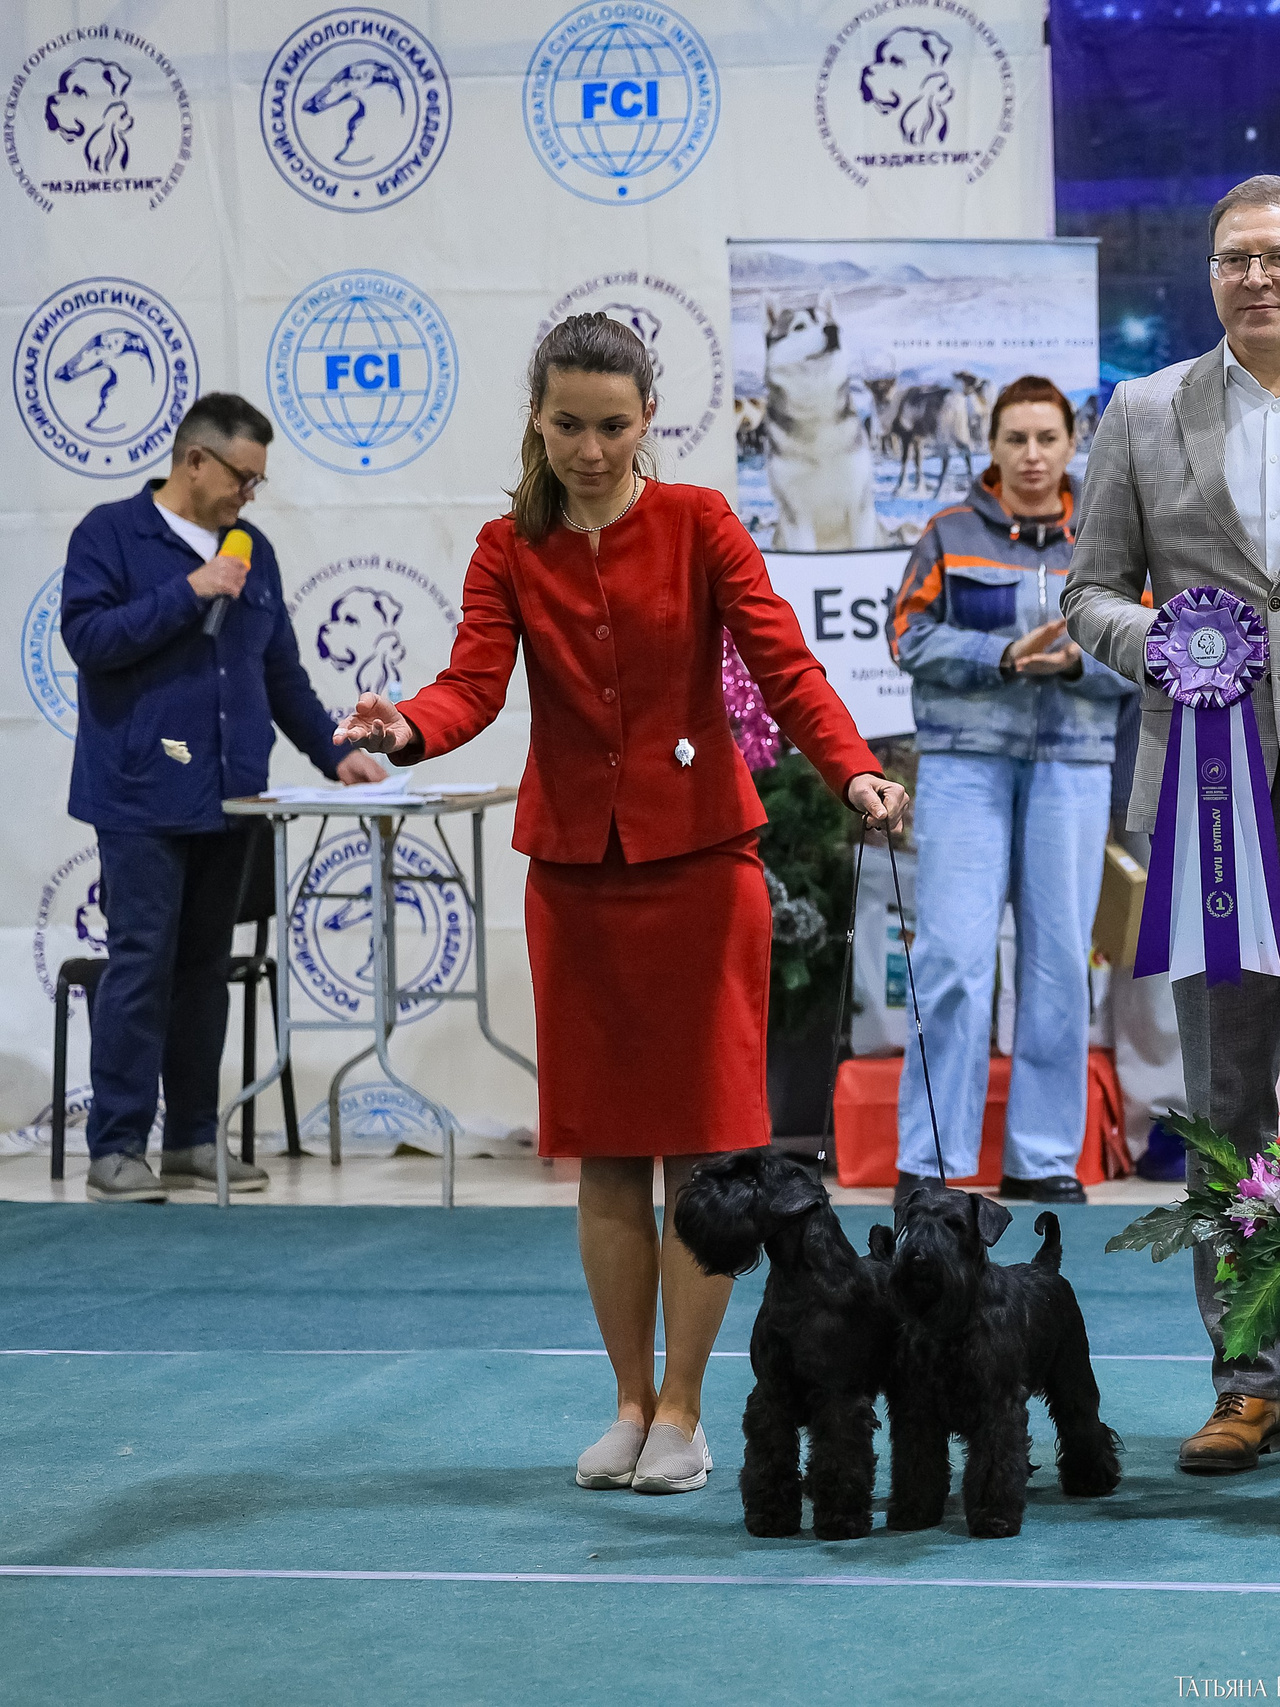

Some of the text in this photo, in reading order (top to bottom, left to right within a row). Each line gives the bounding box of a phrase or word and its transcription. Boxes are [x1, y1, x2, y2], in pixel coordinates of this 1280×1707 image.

[271, 20, 441, 197] РОССИЙСКАЯ КИНОЛОГИЧЕСКАЯ ФЕДЕРАЦИЯ
[532, 57, 568, 170] FEDERATION
[668, 26, 711, 172] INTERNATIONALE
[582, 80, 659, 119] FCI
[32, 289, 183, 352] КИНОЛОГИЧЕСКАЯ
[275, 328, 312, 440] FEDERATION
[408, 299, 451, 444] INTERNATIONALE
[325, 353, 400, 390] FCI
[24, 346, 90, 464] РОССИЙСКАЯ
[30, 607, 66, 718] FEDERATION
[1212, 808, 1223, 884] ЛУЧШАЯ ПАРА
[1216, 897, 1225, 911] 1
[400, 911, 462, 1013] ФЕДЕРАЦЯ
